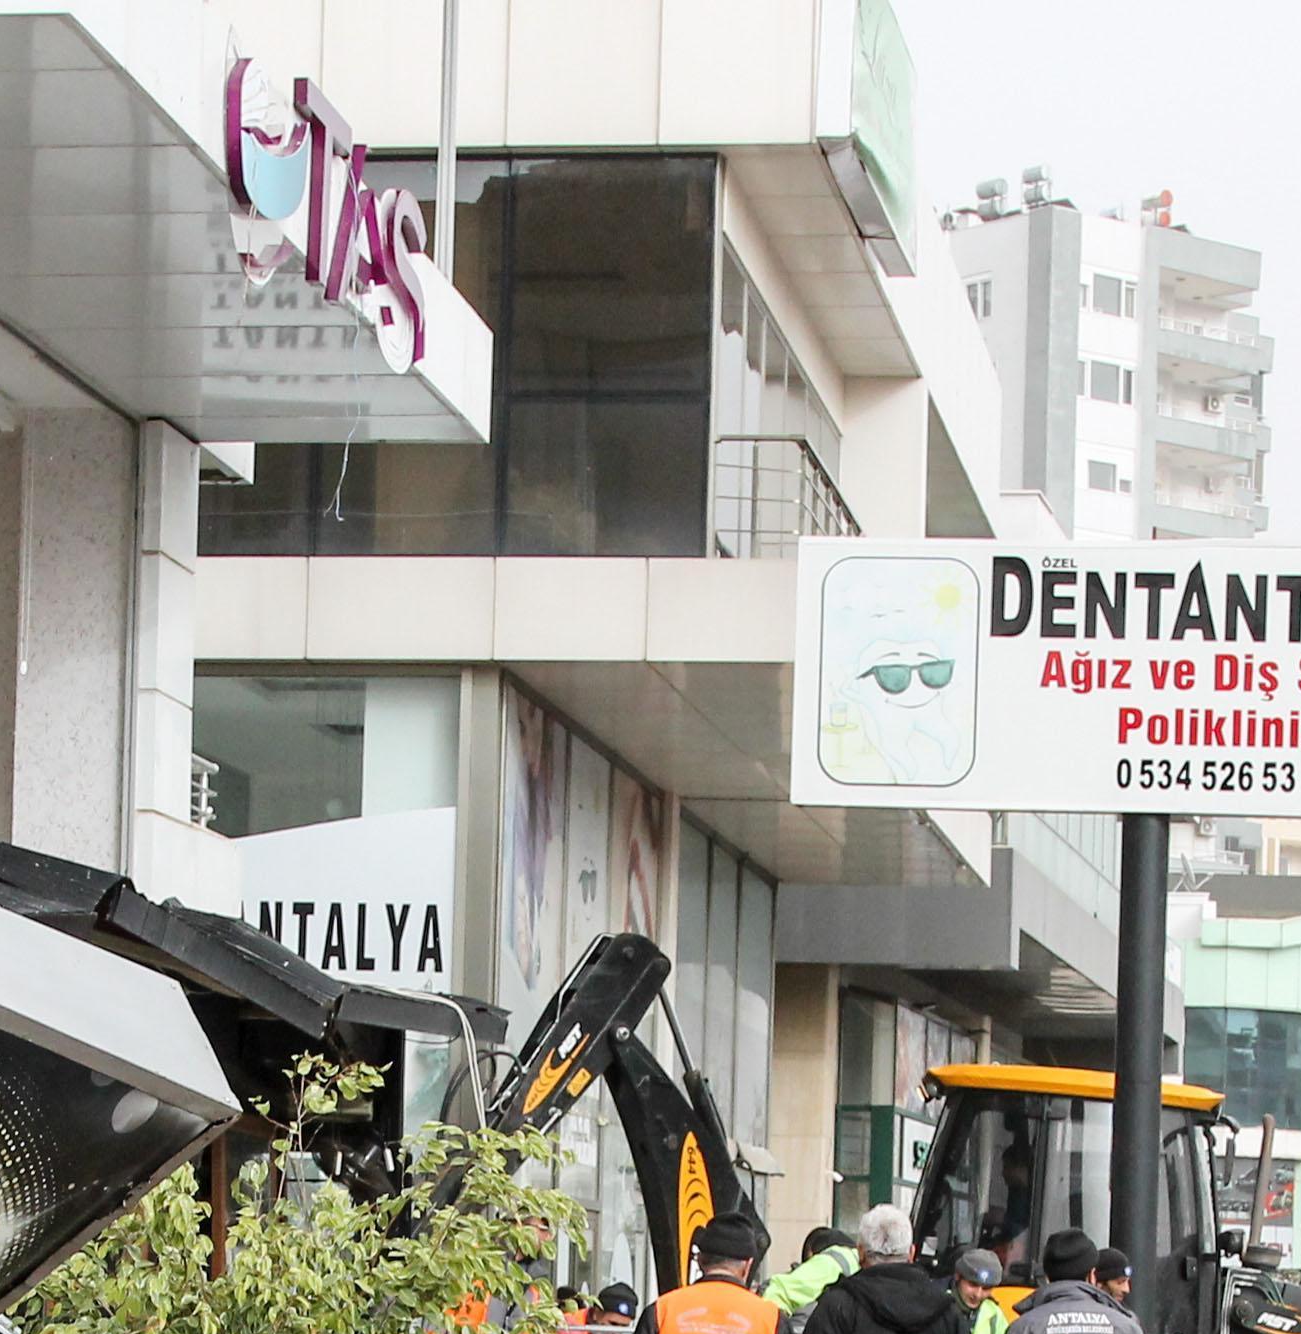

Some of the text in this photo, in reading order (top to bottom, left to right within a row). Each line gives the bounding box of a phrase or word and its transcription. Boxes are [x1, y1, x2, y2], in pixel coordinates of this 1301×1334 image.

[1042, 556, 1078, 568] ÖZEL
[1040, 650, 1132, 694] Ağız
[1149, 659, 1196, 690] ve
[1213, 653, 1280, 701] Diş
[1116, 758, 1132, 789] 0
[1140, 759, 1192, 790] 534
[1202, 761, 1254, 791] 526
[1262, 762, 1296, 792] 53
[241, 900, 443, 973] NTALYA
[1047, 1311, 1112, 1327] ANTALYA
